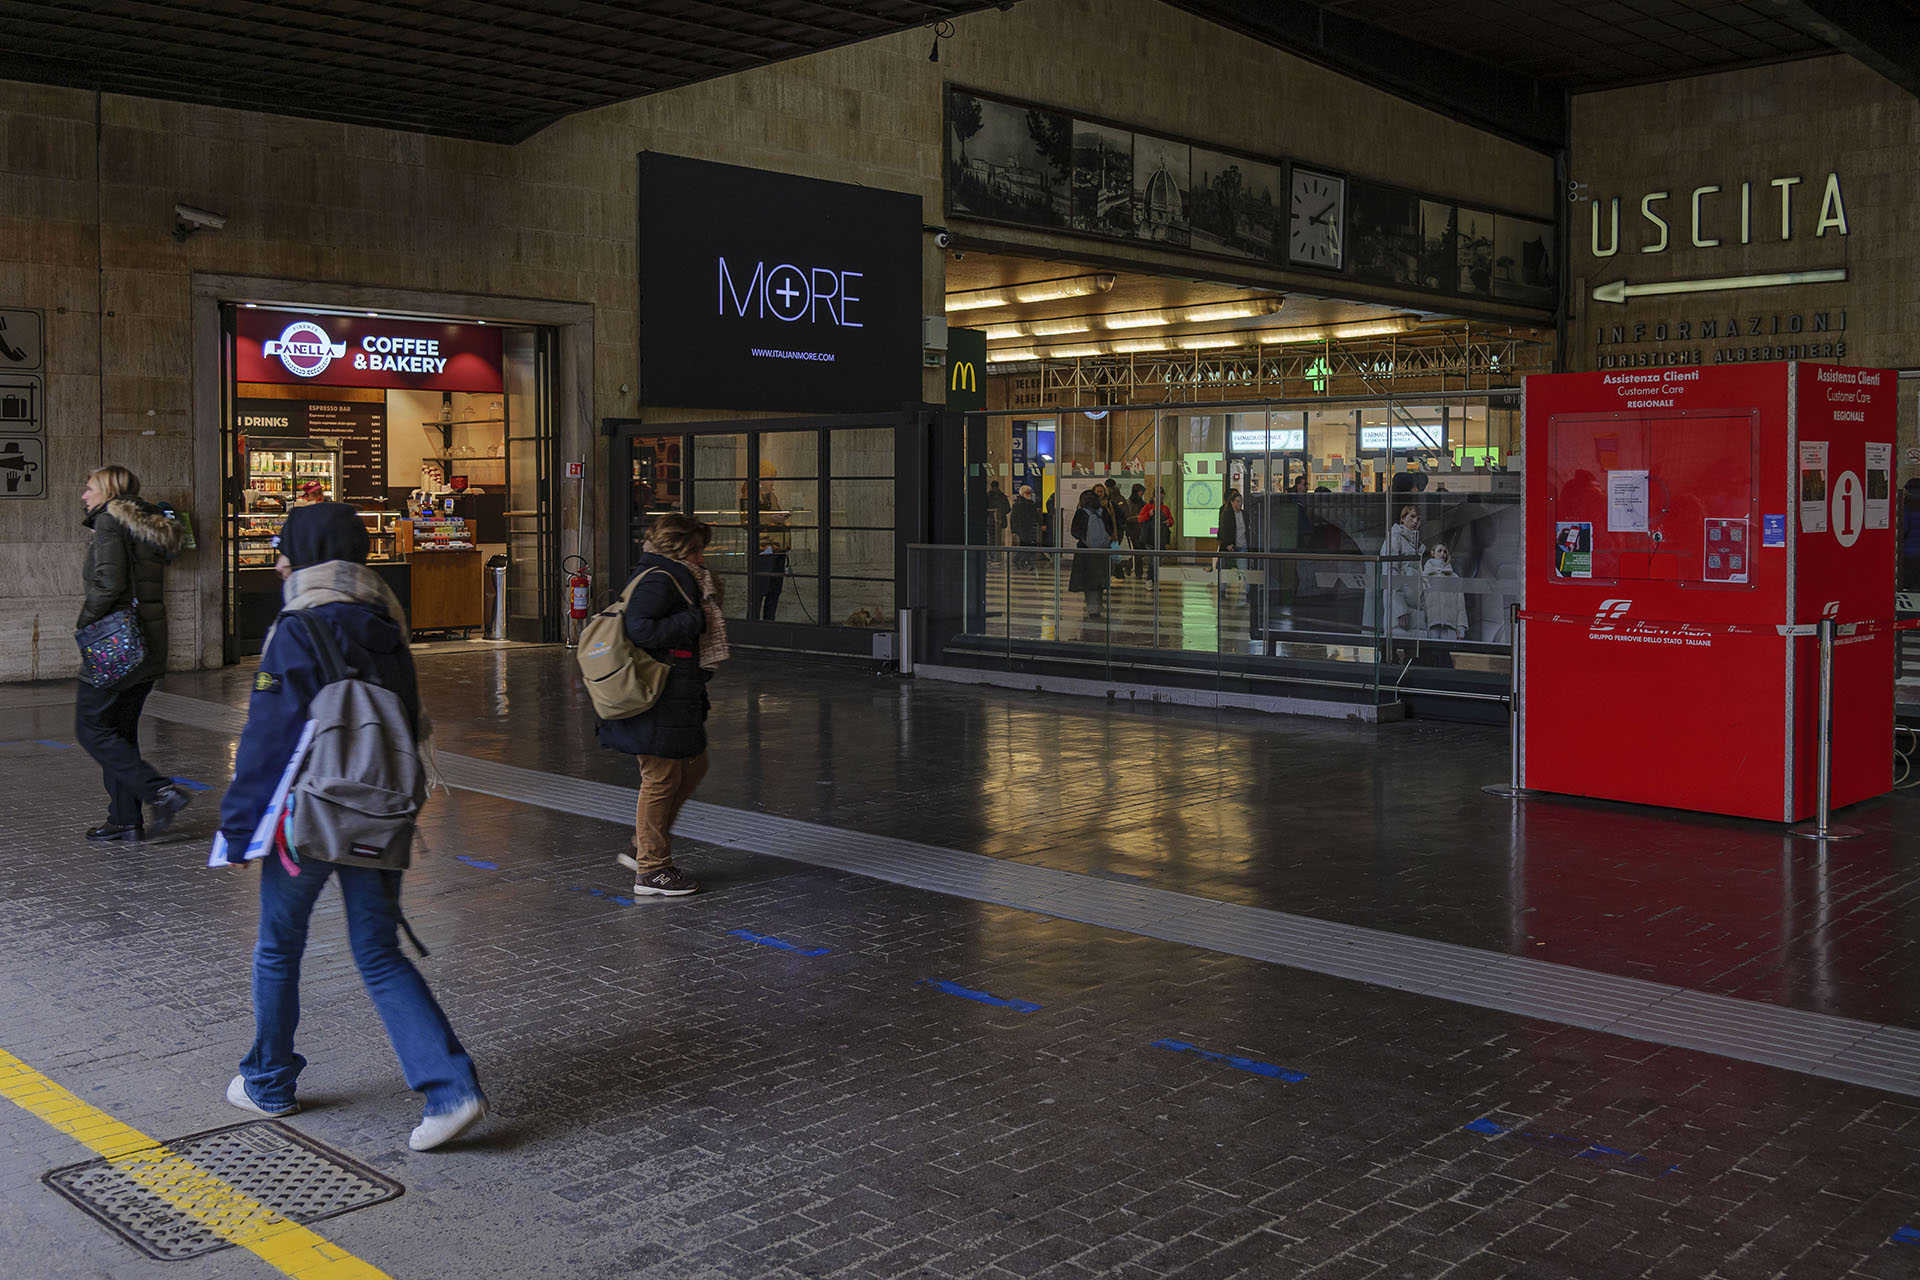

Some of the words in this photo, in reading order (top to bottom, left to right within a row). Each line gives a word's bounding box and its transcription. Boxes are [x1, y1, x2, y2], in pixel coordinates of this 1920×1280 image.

[1592, 172, 1848, 257] USCITA
[719, 256, 863, 327] MORE
[1597, 312, 1847, 344] INFORMAZIONI
[274, 343, 335, 356] PANELLA
[363, 336, 439, 356] COFFEE
[751, 348, 835, 362] WWW.ITALIANMORE.COM
[1597, 350, 1701, 369] TURISTICHE
[1714, 343, 1847, 364] ALBERGHIERE
[370, 356, 447, 374] BAKERY
[1603, 373, 1660, 384] Assistenza
[1663, 370, 1699, 382] Clienti
[1817, 368, 1856, 384] Assistenza
[1857, 372, 1880, 386] Clienti
[1617, 385, 1659, 396] Customer
[1661, 384, 1684, 394] Care
[1827, 387, 1855, 401] Customer
[1856, 389, 1871, 403] Care
[1627, 399, 1674, 408] REGIONALE
[244, 416, 289, 427] DRINKS
[1833, 411, 1864, 421] REGIONALE
[1589, 633, 1613, 641] GRUPPO
[1614, 635, 1642, 643] FERROVIE
[1662, 637, 1682, 645] STATO
